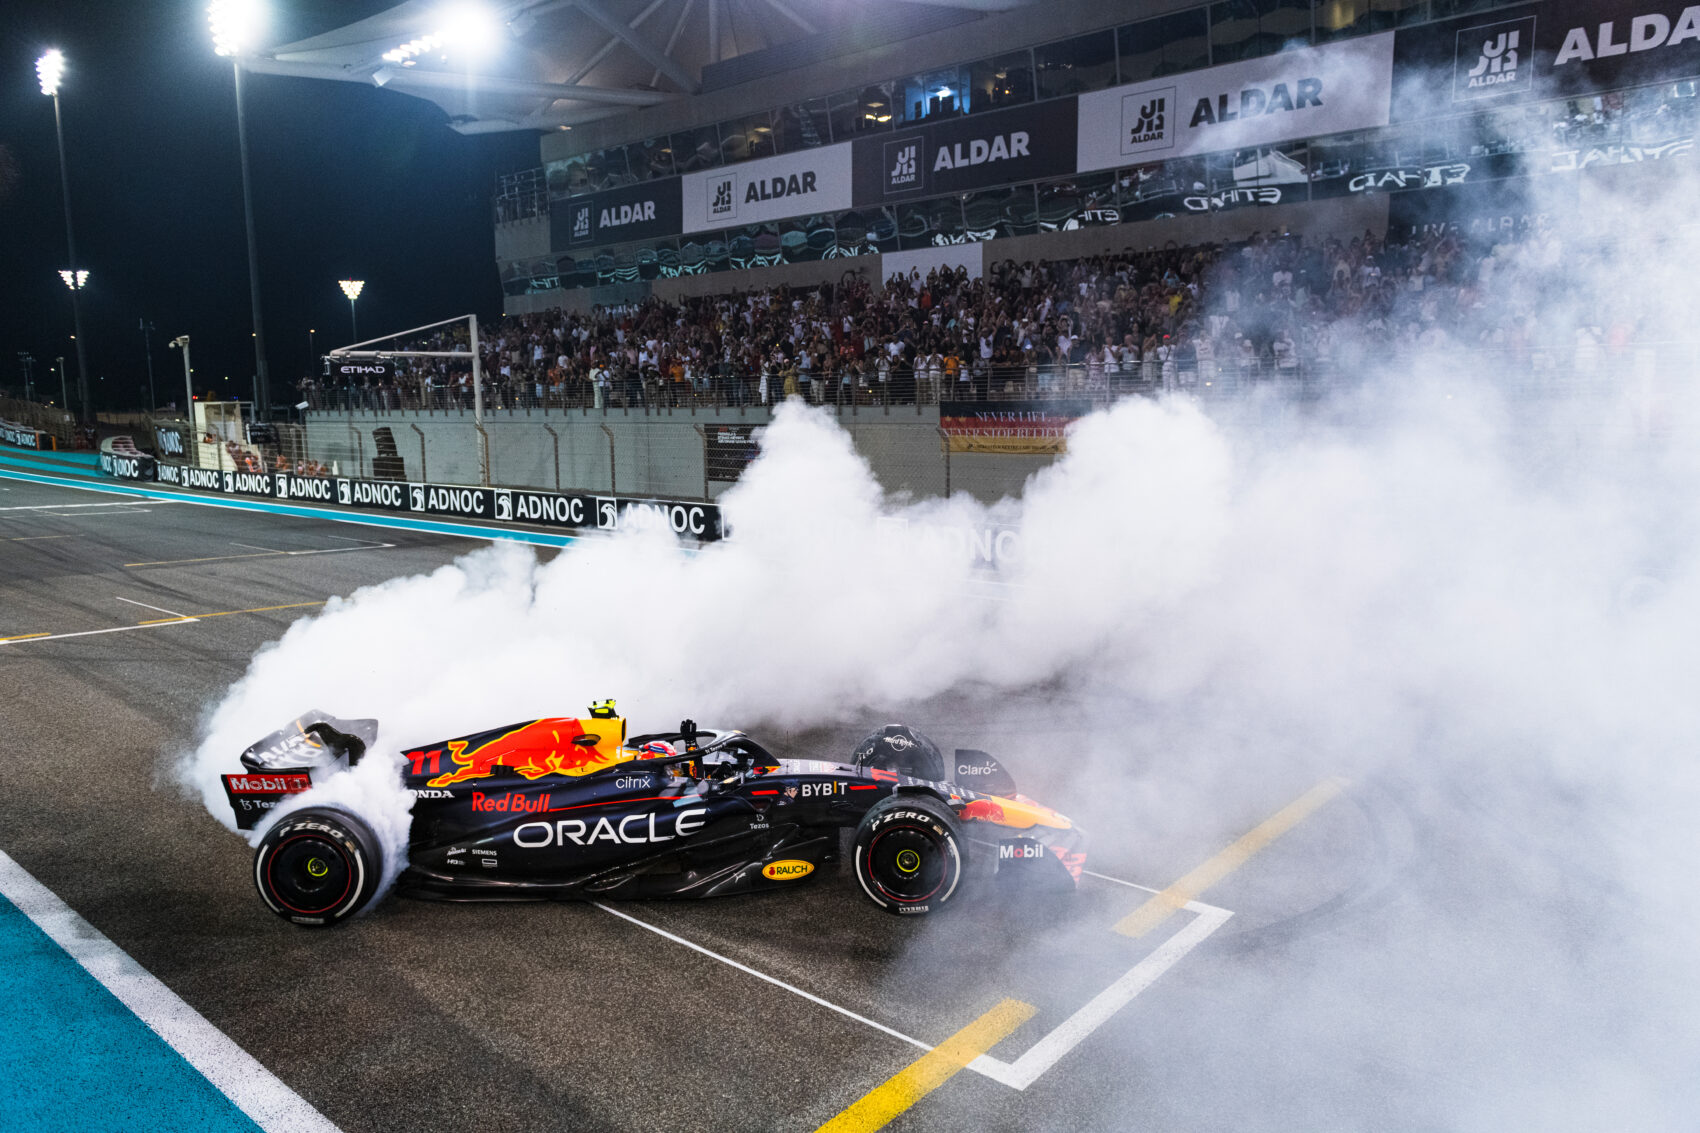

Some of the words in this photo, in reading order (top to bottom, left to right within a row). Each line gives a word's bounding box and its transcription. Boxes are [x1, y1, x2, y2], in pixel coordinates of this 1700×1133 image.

[1468, 72, 1516, 88] ALDAR
[1189, 77, 1324, 128] ALDAR
[1131, 132, 1164, 144] ALDAR
[933, 131, 1030, 172] ALDAR
[745, 171, 816, 204] ALDAR
[891, 174, 915, 184] ALDAR
[600, 201, 656, 229] ALDAR
[712, 205, 731, 214] ALDAR
[340, 365, 385, 374] ETIHAD
[975, 411, 1015, 422] NEVER
[190, 469, 219, 489] ADNOC
[235, 474, 271, 494] ADNOC
[289, 477, 331, 500] ADNOC
[353, 483, 402, 507] ADNOC
[427, 487, 485, 514] ADNOC
[516, 495, 584, 523] ADNOC
[623, 502, 705, 534] ADNOC
[406, 750, 442, 775] 11
[958, 764, 992, 776] Claro
[230, 777, 287, 791] Mobil
[615, 775, 651, 789] citrix
[801, 780, 848, 797] BYBIT
[409, 789, 455, 799] ONDA
[472, 791, 511, 812] Red
[511, 793, 551, 812] Bull
[252, 800, 278, 809] Tez
[513, 808, 707, 848] ORACLE
[750, 822, 769, 830] Tezos
[872, 819, 880, 831] P
[883, 811, 930, 823] ZERO
[293, 822, 344, 839] ZERO
[1000, 844, 1043, 858] Mobil
[776, 865, 808, 875] RAUCH
